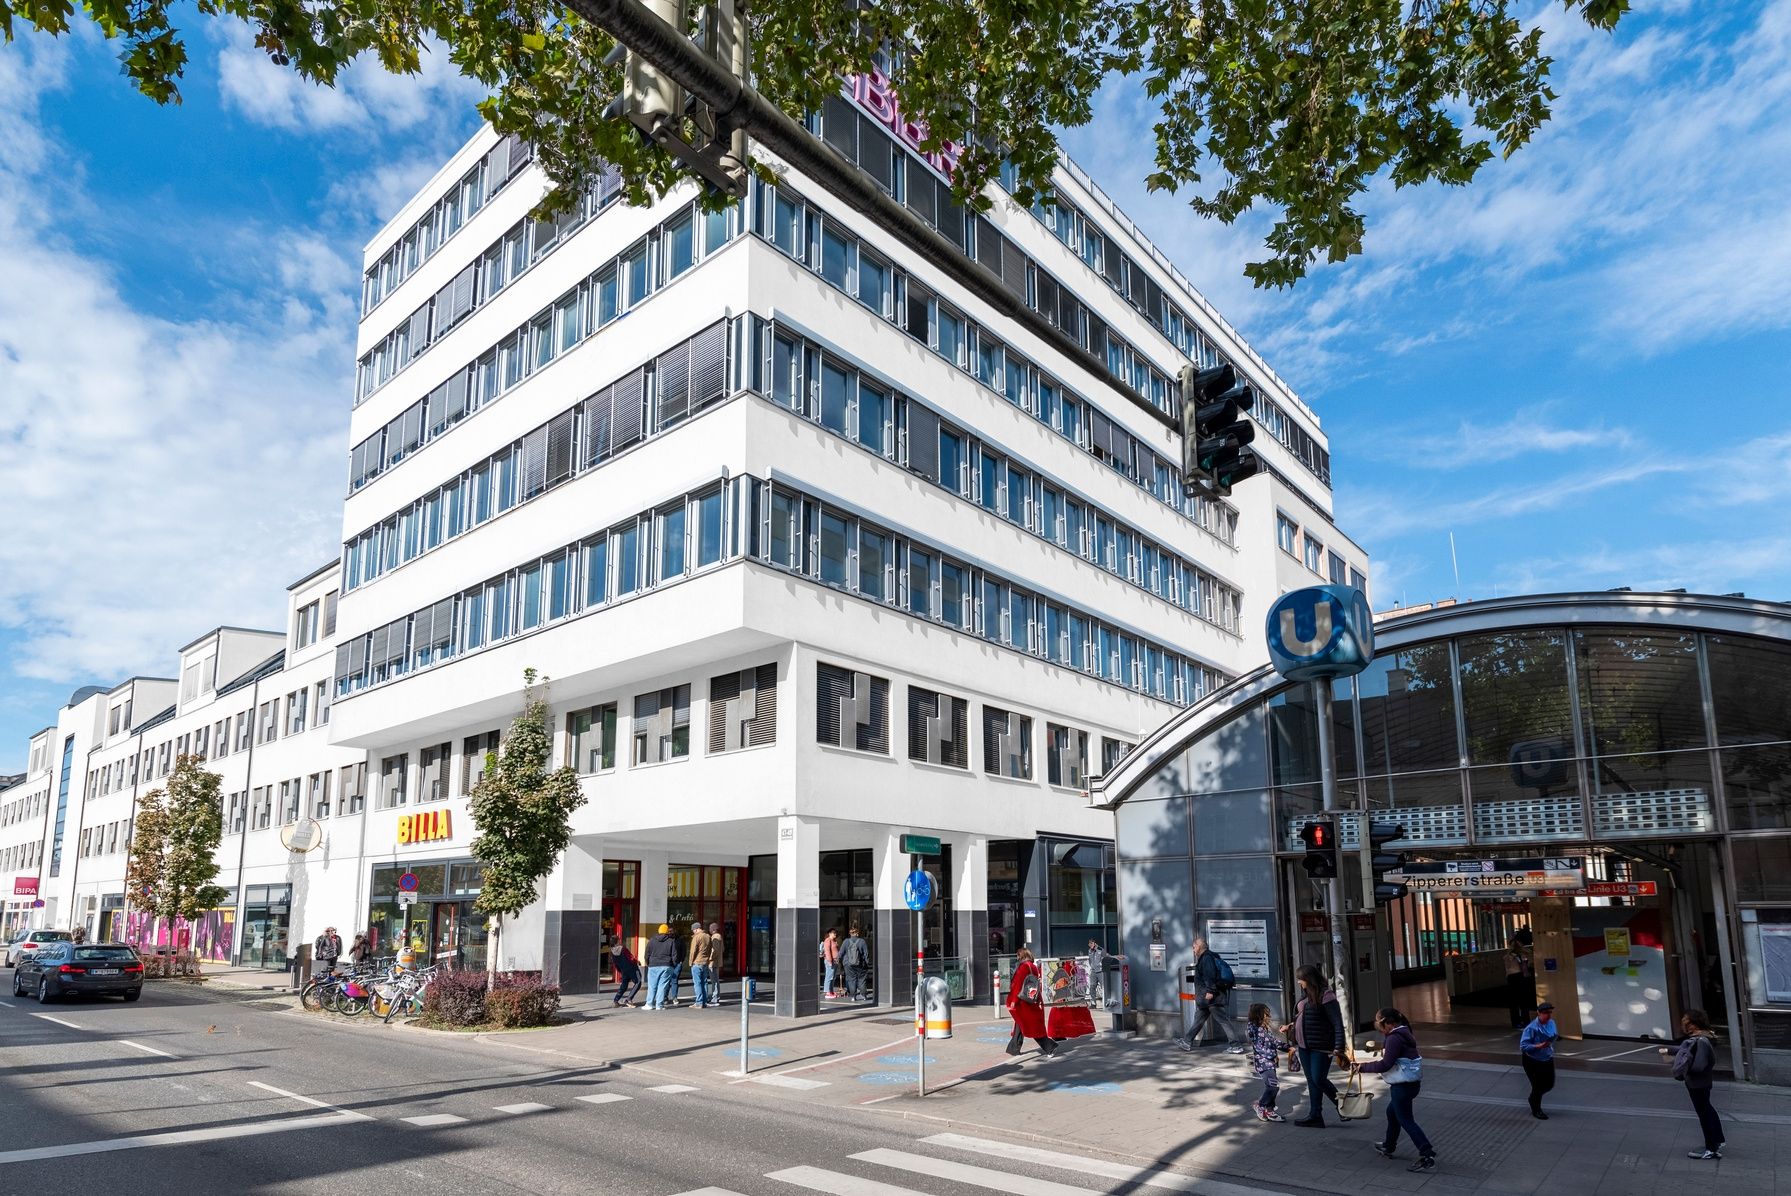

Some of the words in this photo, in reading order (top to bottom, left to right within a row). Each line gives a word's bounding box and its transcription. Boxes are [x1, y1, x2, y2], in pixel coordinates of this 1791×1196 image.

[1280, 601, 1333, 657] U
[1354, 601, 1373, 659] U
[398, 808, 452, 845] BILLA
[1402, 873, 1525, 890] Zippererstraße
[1588, 885, 1611, 893] Linie
[1613, 884, 1627, 893] U3
